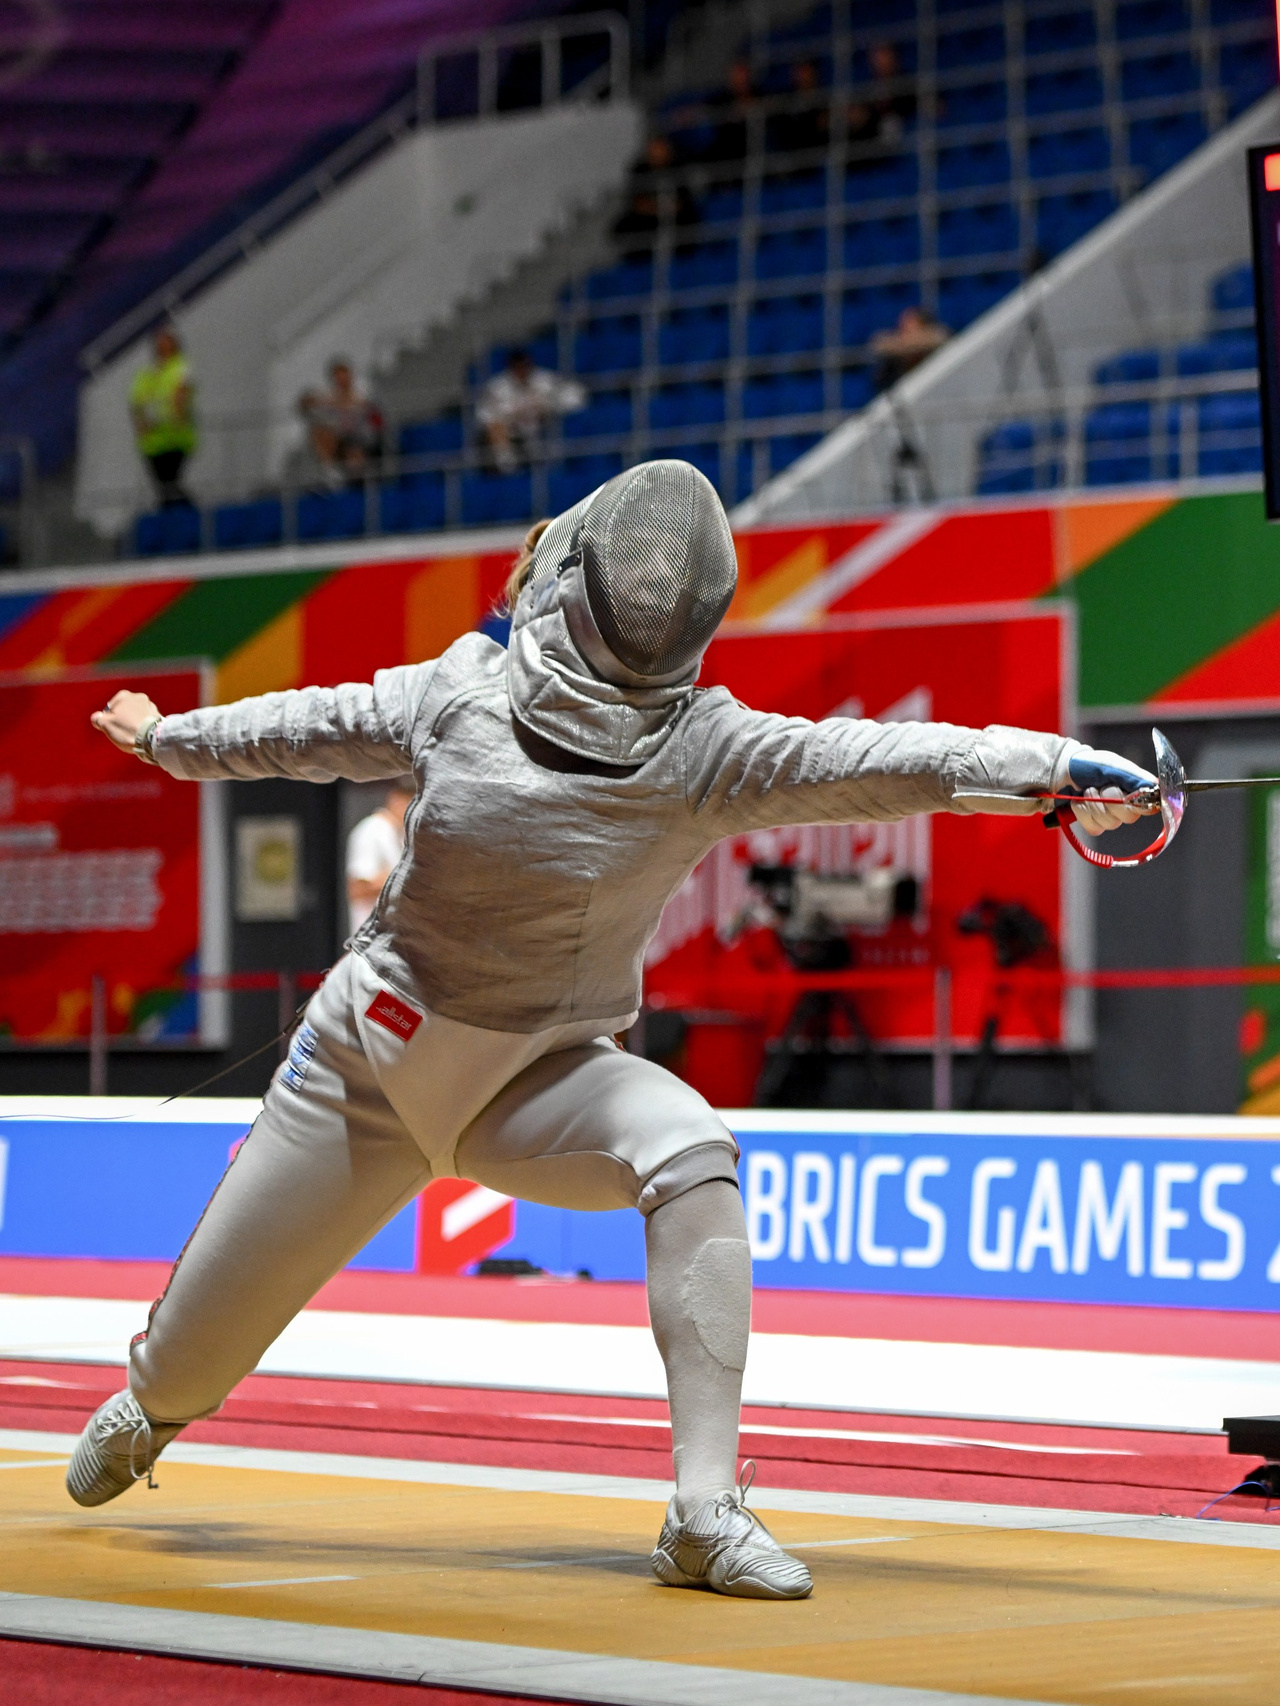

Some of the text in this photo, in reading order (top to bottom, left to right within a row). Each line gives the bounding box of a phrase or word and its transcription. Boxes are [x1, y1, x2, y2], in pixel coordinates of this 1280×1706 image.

[376, 1005, 412, 1031] allstar
[747, 1151, 948, 1269] BRICS
[968, 1158, 1246, 1280] GAMES
